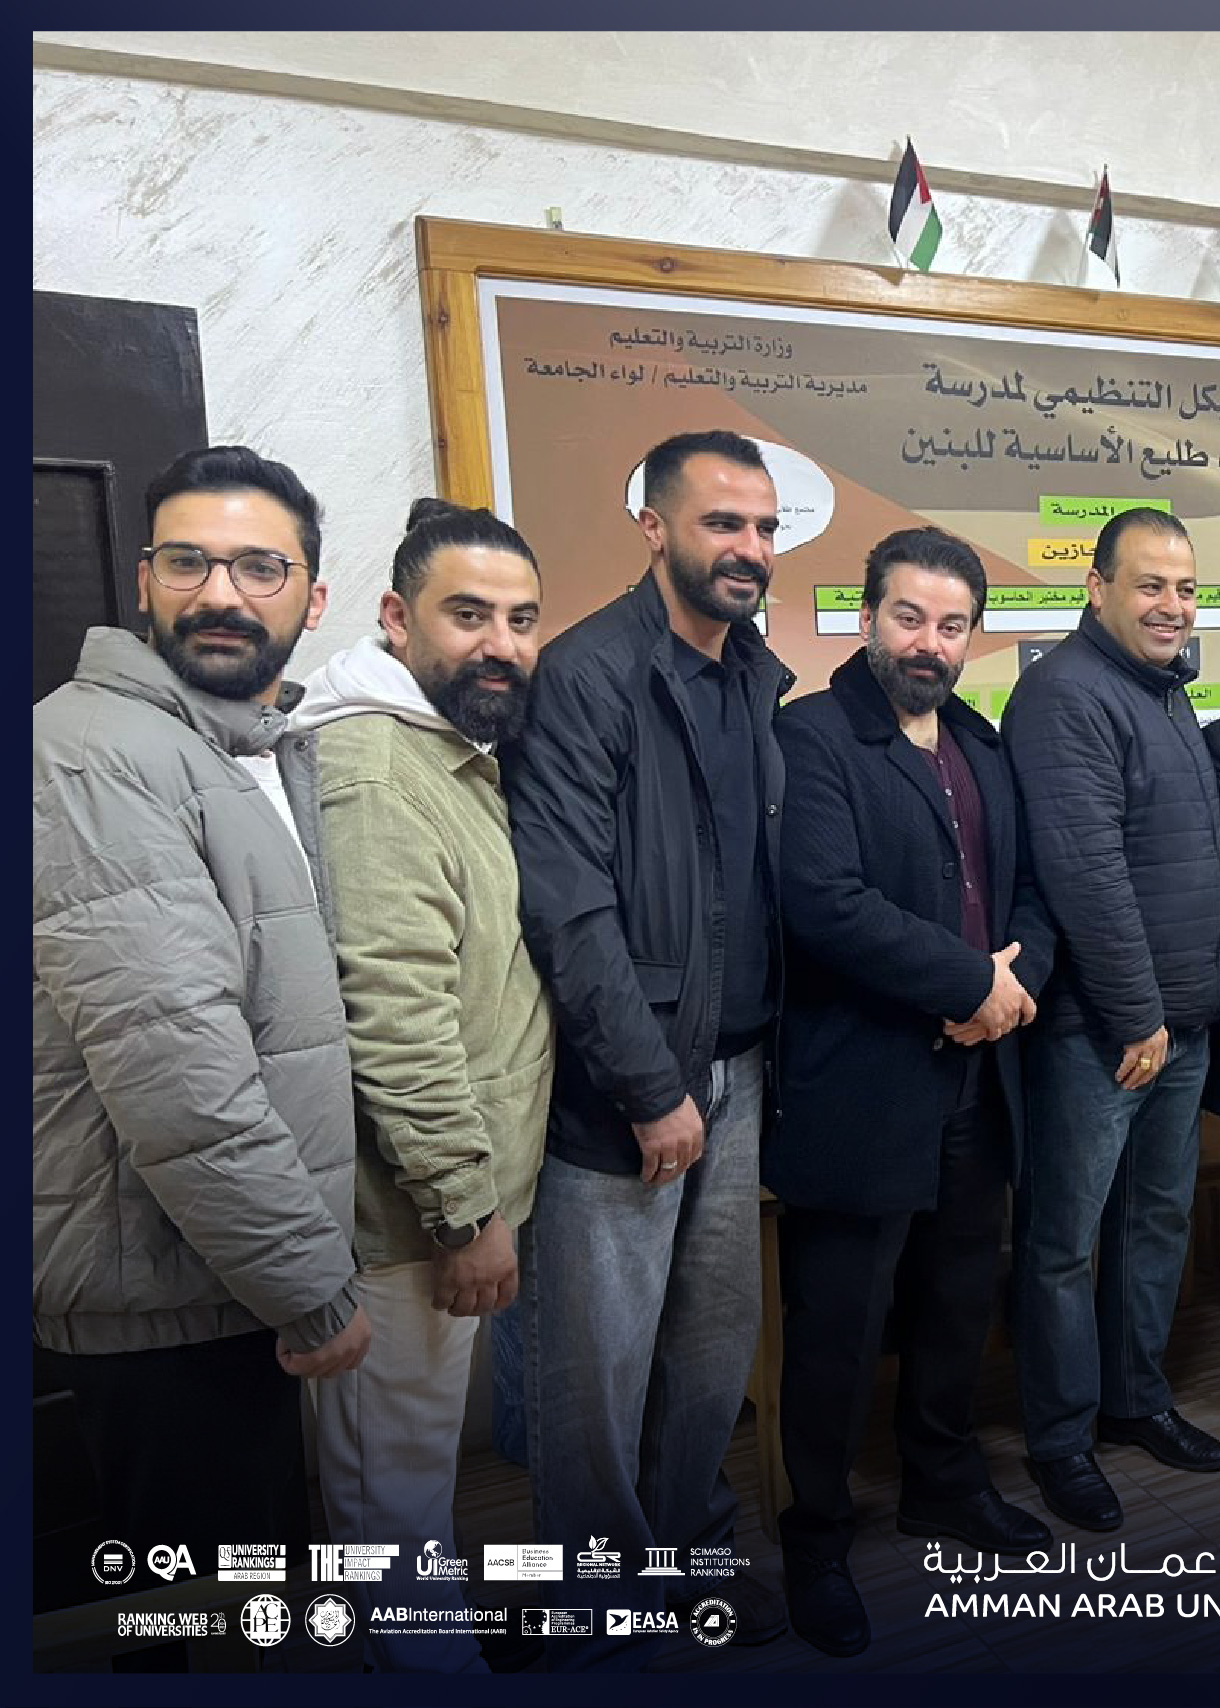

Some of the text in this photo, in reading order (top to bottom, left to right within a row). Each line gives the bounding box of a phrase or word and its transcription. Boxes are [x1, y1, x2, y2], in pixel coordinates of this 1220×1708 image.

[609, 326, 793, 359] وزارة التربية والتعليم
[524, 357, 605, 382] الجامعة
[610, 364, 644, 386] لواء
[663, 366, 736, 391] والتعليم
[736, 369, 801, 394] التربية
[802, 374, 868, 398] مديرية
[922, 363, 1027, 408] لمدرسة
[1033, 375, 1172, 420] التنظيمي
[902, 428, 997, 471] للبنين
[1002, 425, 1133, 471] الأساسية
[1141, 438, 1209, 480] طليع
[1050, 503, 1115, 519] المدرسة
